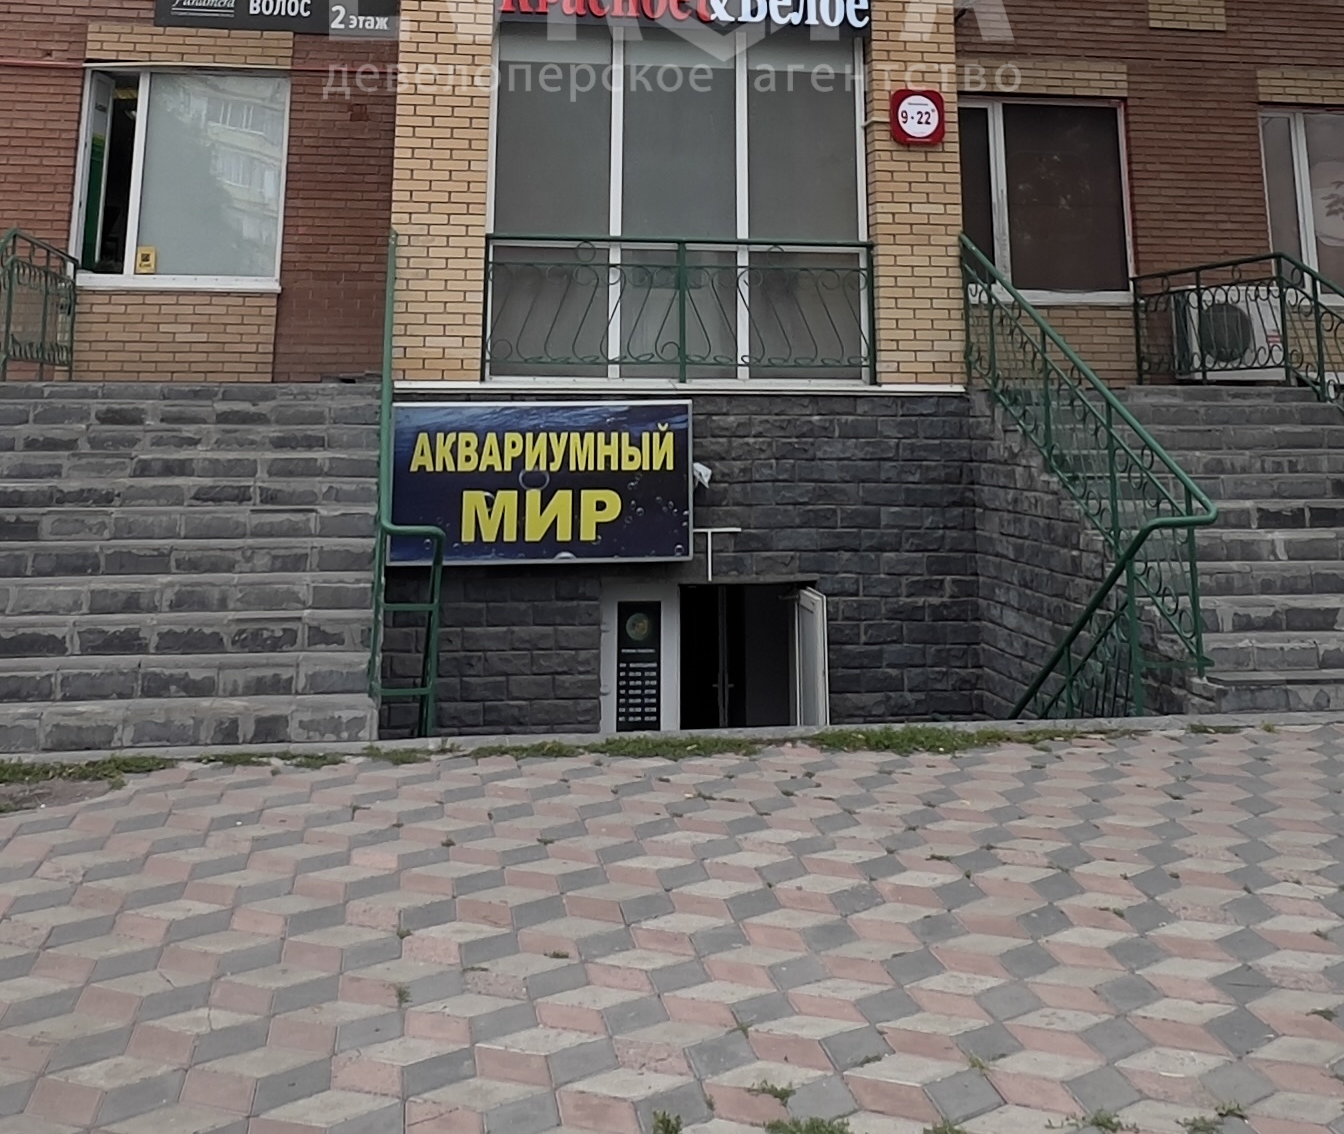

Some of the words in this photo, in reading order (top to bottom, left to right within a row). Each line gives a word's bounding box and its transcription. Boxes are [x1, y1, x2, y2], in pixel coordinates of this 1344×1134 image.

[330, 5, 346, 29] 2
[349, 15, 389, 30] этаж
[409, 423, 674, 472] АКВАРИУМНЫЙ
[460, 488, 622, 543] МИР
